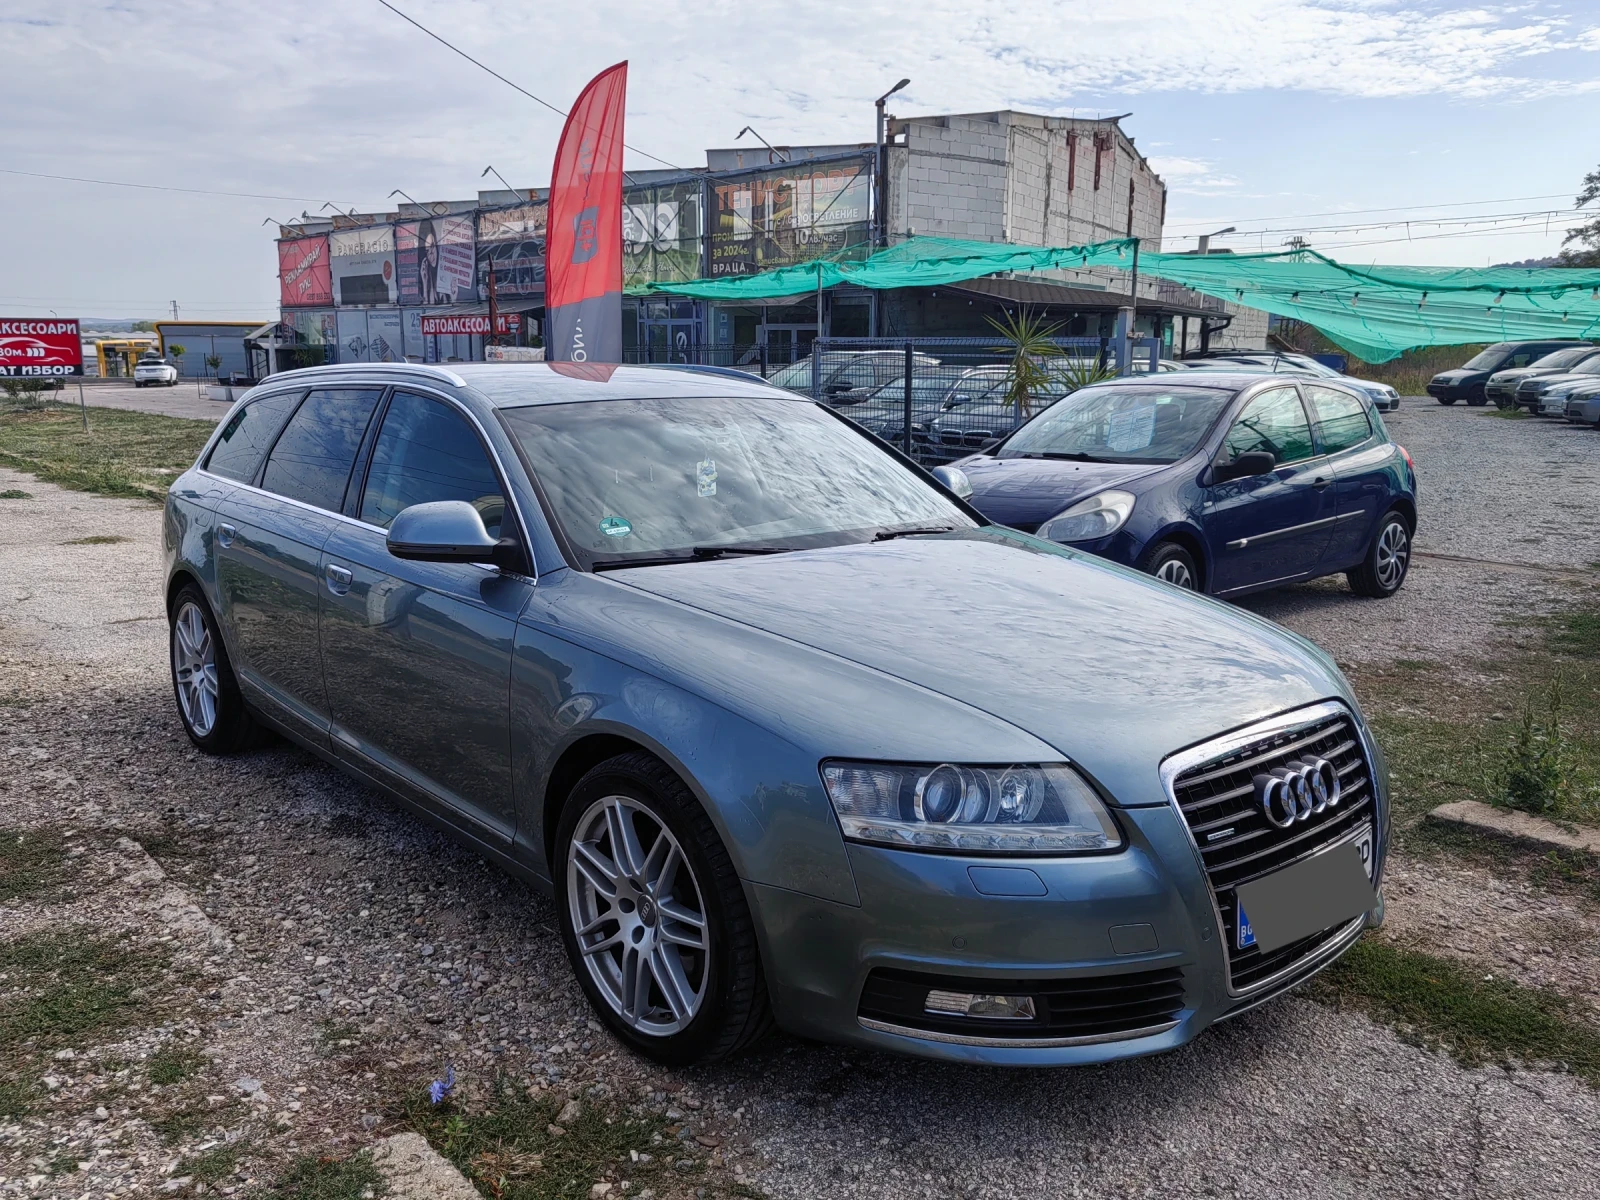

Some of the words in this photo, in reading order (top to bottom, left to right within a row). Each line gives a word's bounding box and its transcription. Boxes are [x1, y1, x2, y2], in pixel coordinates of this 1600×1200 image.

[715, 177, 790, 210] ТЕНИС
[796, 166, 860, 201] КОРТ
[712, 248, 722, 260] за
[284, 243, 321, 285] РЕКЛАМИРАЙ
[0, 322, 77, 335] КСЕСОАРИ
[423, 317, 506, 333] АВТОАКСЕСОАИ
[21, 365, 75, 376] ИЗБОР
